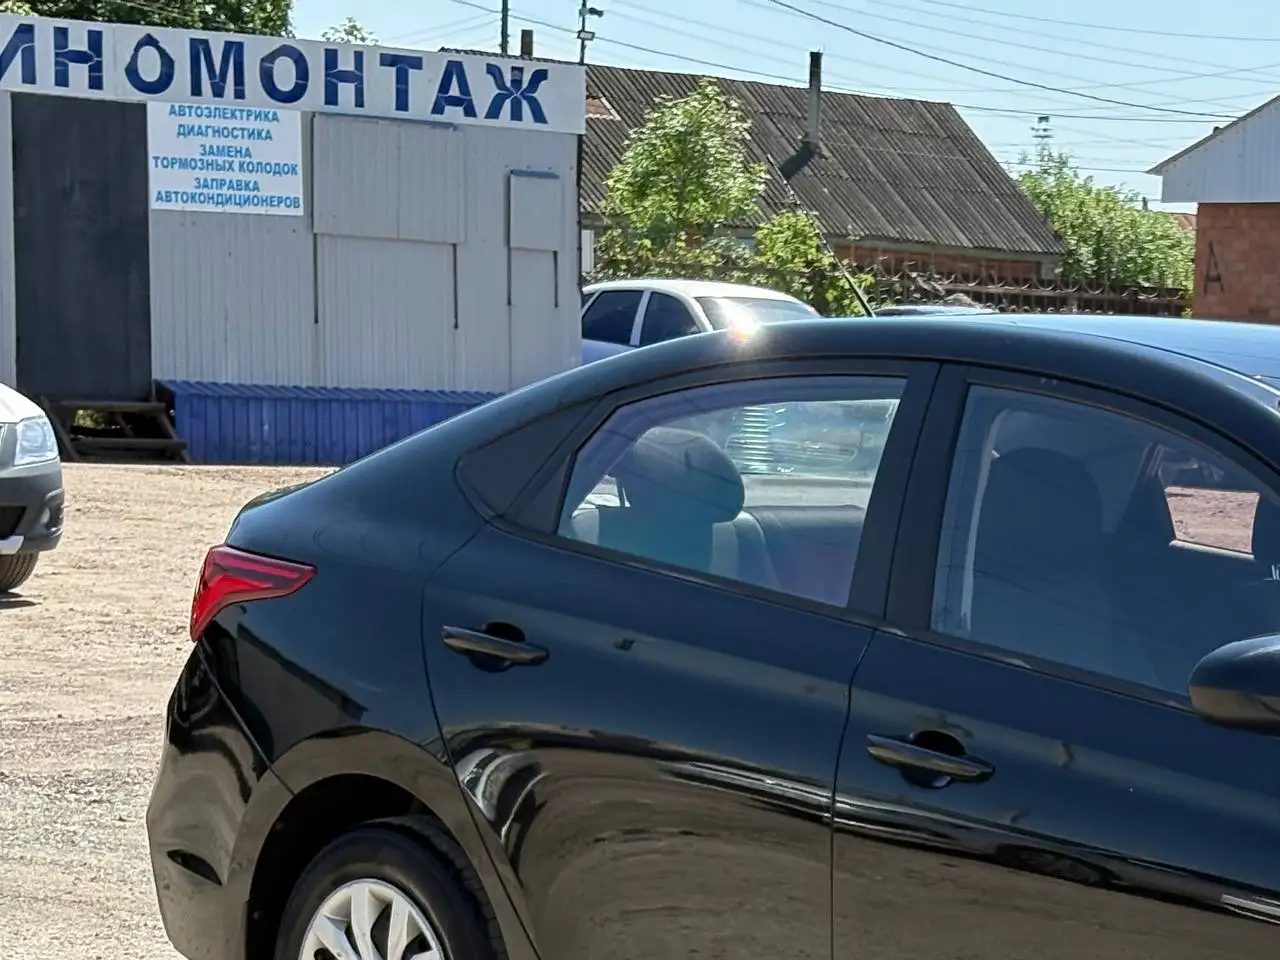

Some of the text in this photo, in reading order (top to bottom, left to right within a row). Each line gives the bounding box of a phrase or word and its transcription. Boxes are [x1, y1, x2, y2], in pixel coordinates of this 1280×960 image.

[168, 104, 280, 123] АВТОЭЛЕКТРИКА
[176, 124, 273, 141] ДИАГНОСТИКА
[199, 143, 253, 159] ЗАМЕНА
[152, 156, 299, 177] ТОРМОЗНЫХ КОЛОДОК
[193, 177, 261, 193] ЗАПРАВКА
[155, 190, 301, 209] АВТОКОНДИЦИОНЕРОВ
